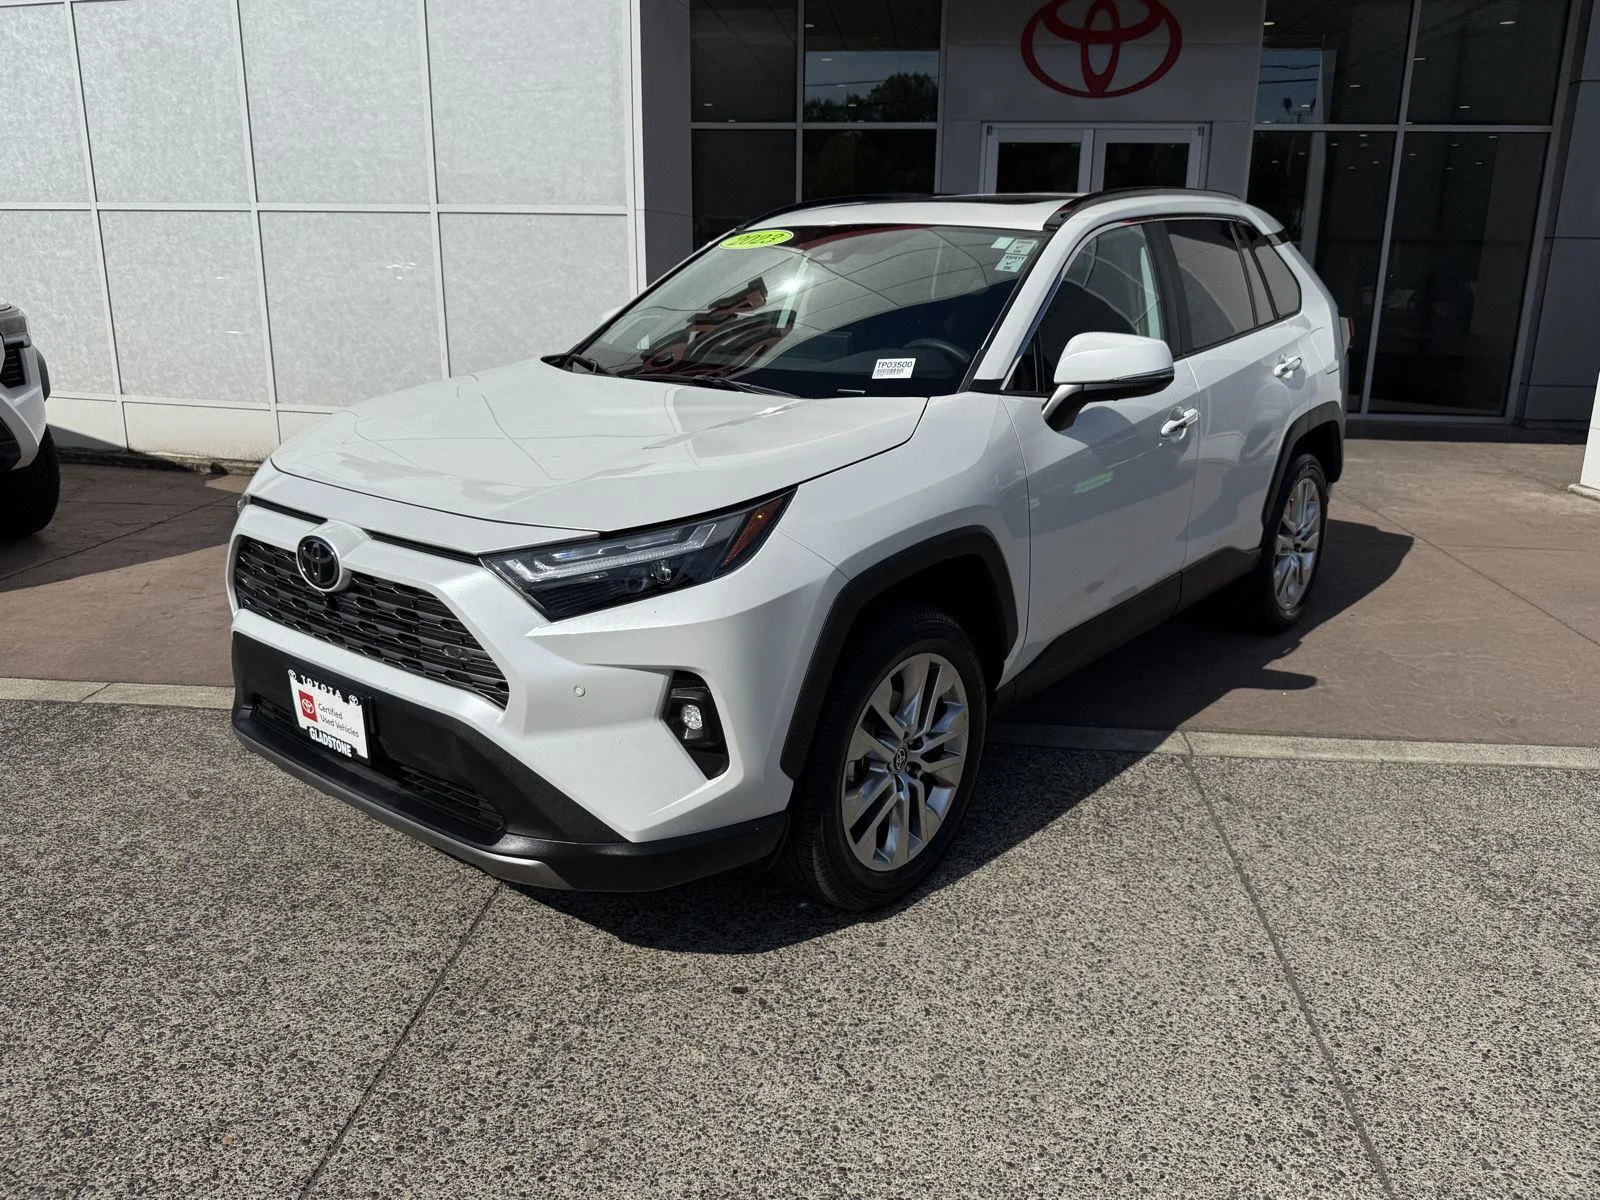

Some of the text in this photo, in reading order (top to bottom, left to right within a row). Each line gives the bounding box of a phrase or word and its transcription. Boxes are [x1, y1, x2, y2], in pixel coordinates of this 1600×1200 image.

[726, 233, 785, 245] 2023
[877, 361, 913, 369] TP03500
[301, 674, 341, 698] TOYOTA
[318, 703, 343, 720] Certified
[320, 714, 360, 738] Used Vehicles
[308, 727, 352, 757] GLADSTONE
